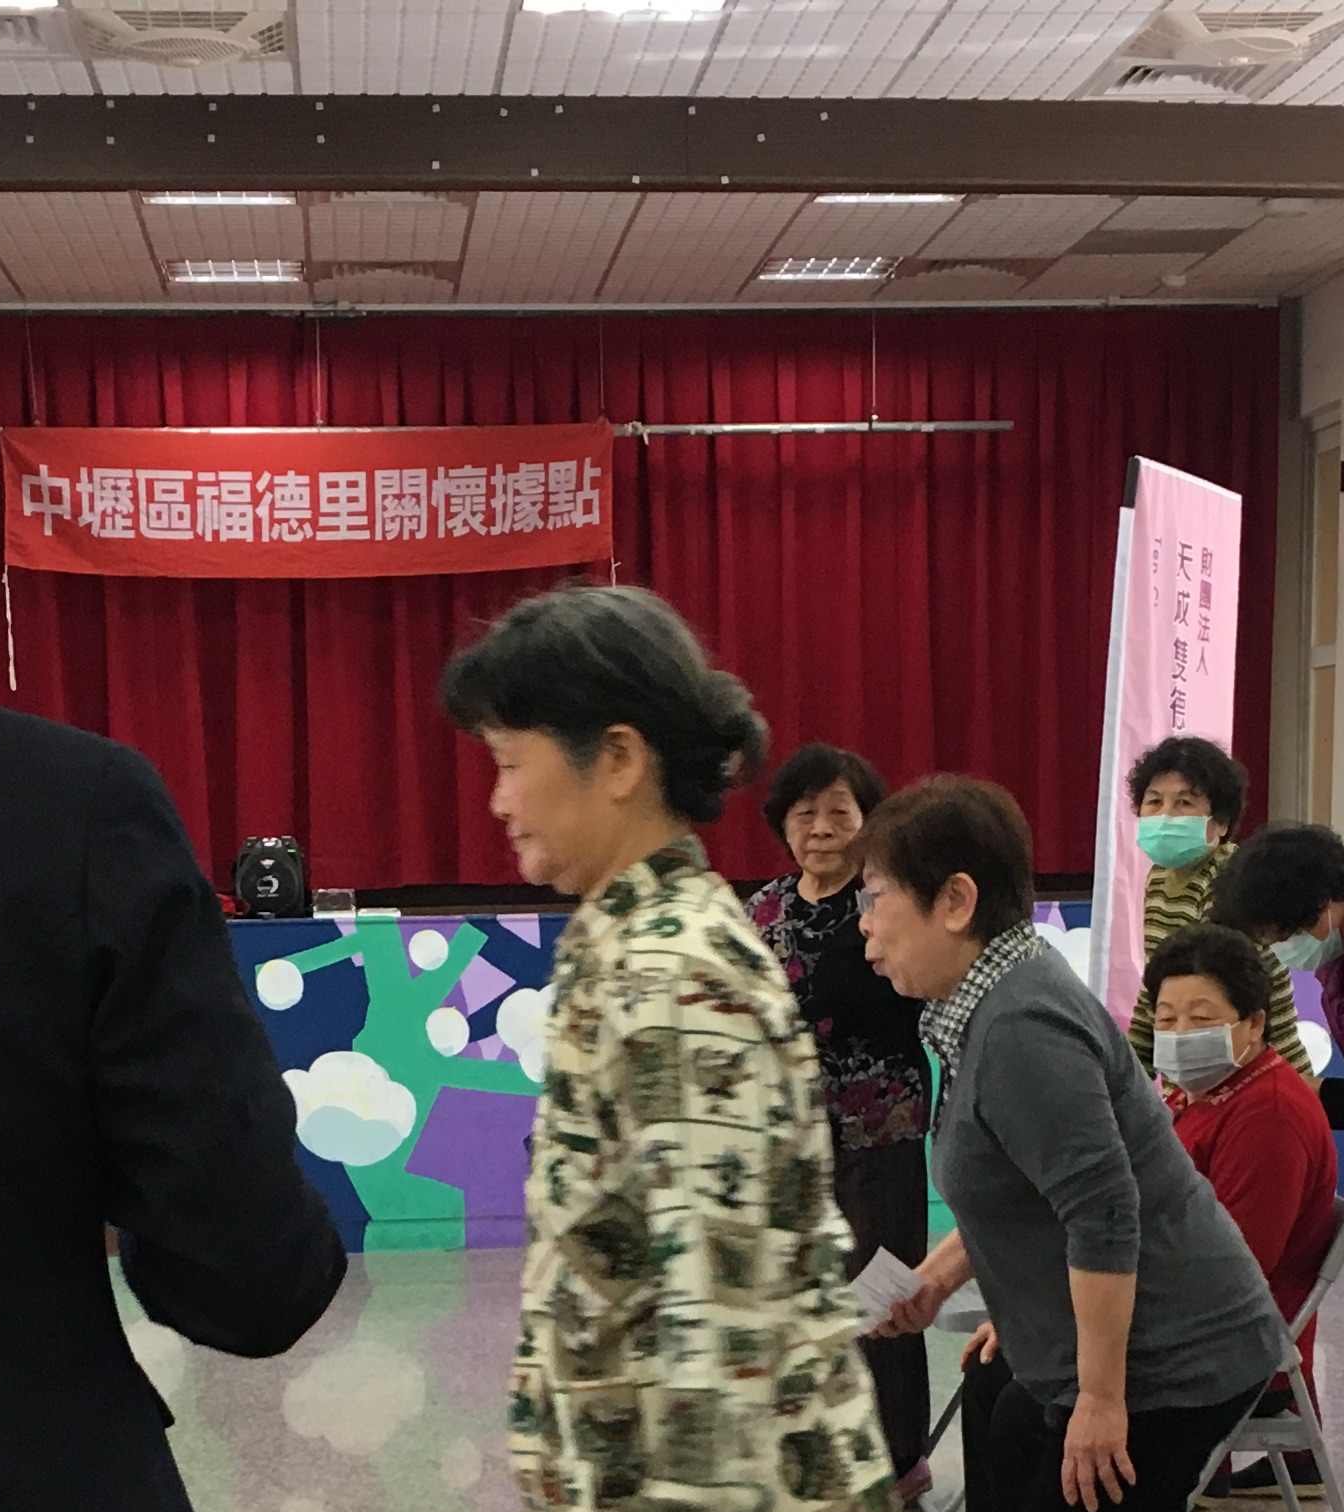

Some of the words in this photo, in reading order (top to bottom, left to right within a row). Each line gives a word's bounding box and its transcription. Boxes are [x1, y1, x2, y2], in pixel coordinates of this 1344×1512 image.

[20, 456, 604, 543] 中壢區福德里關懷據點
[1195, 547, 1213, 676] 財團法人
